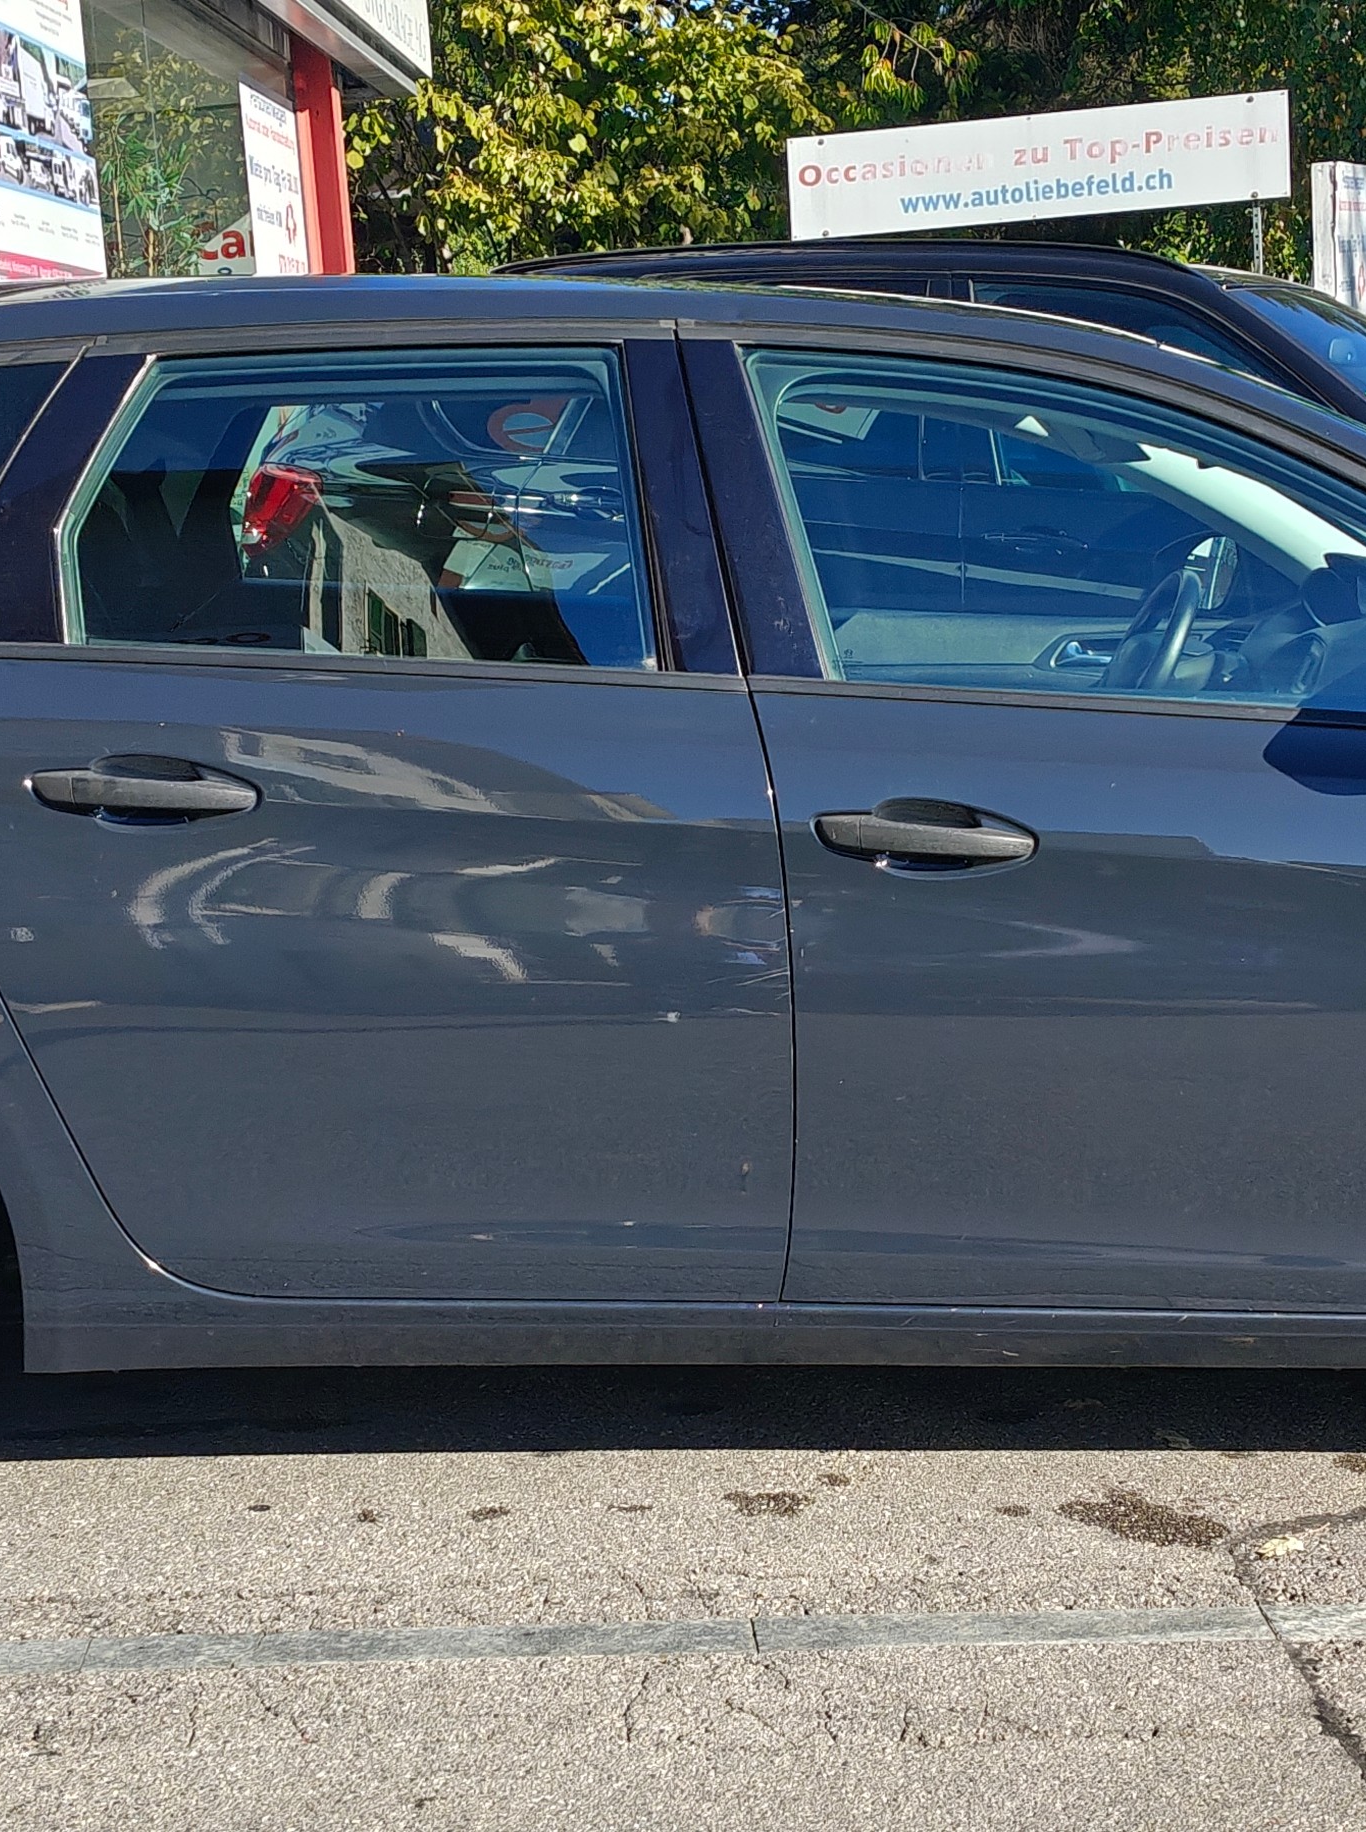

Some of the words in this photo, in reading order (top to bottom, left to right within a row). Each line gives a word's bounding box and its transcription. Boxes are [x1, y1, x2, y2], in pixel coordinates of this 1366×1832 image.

[1014, 145, 1049, 166] zu
[1063, 126, 1280, 164] Top-Preisen
[899, 168, 1173, 214] www.autoliebefeld.ch
